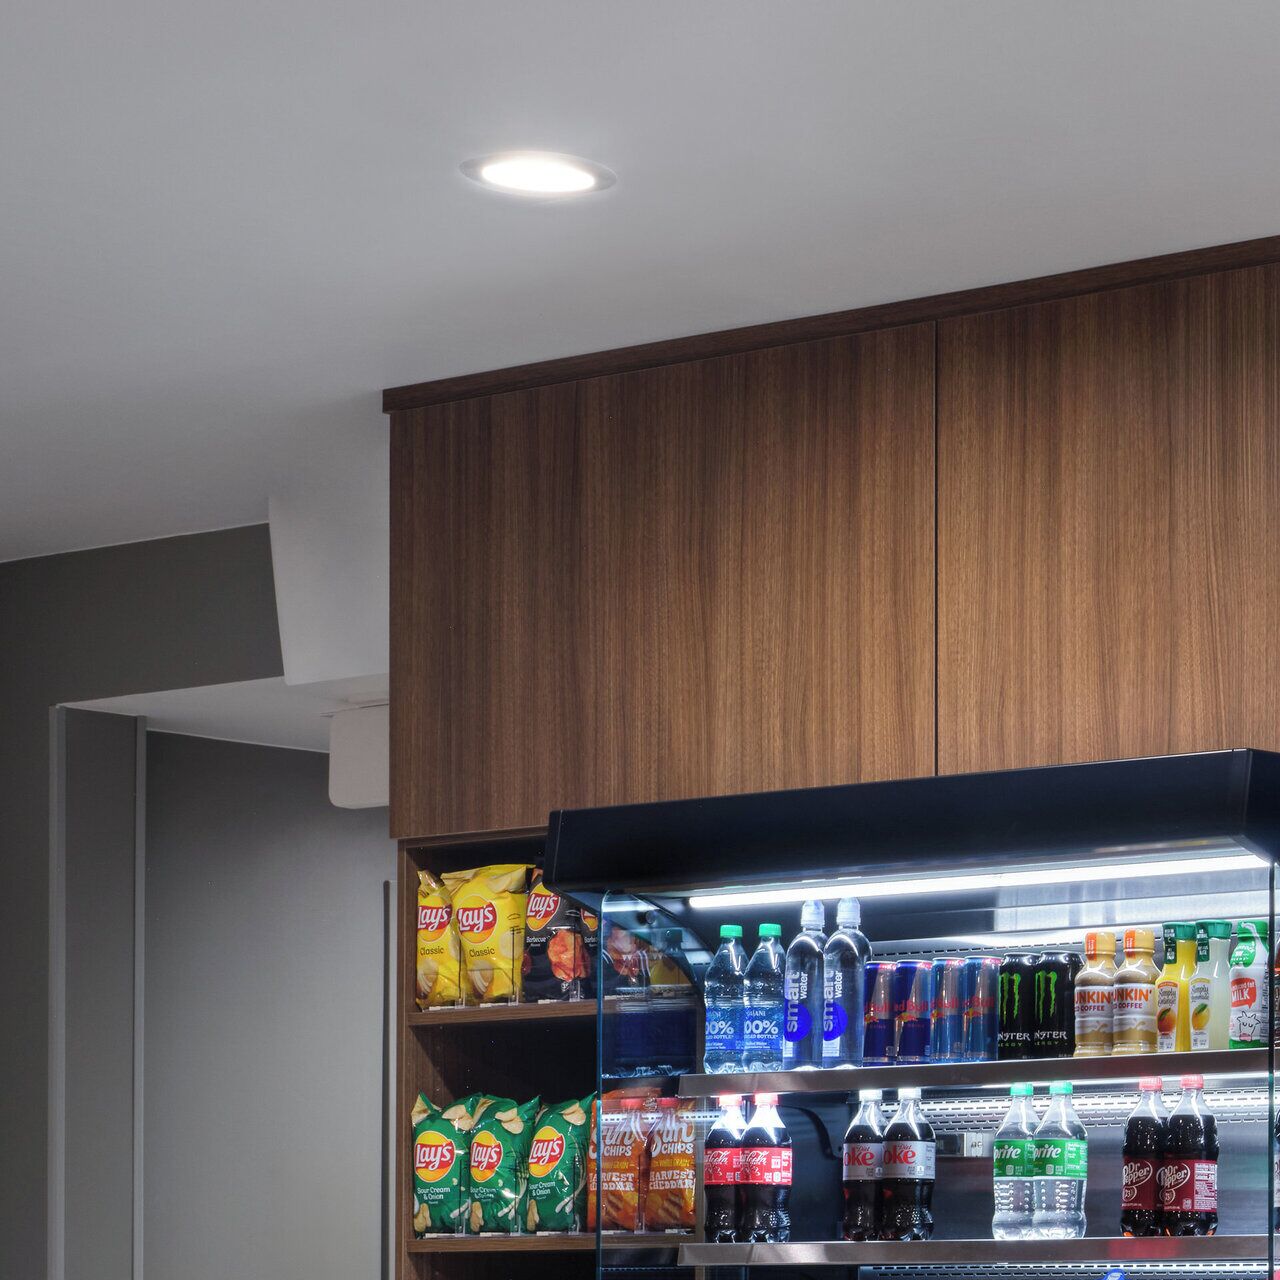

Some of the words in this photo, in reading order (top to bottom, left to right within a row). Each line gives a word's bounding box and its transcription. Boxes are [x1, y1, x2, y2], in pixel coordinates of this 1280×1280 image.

[418, 905, 452, 929] Lay's
[458, 906, 496, 932] Lay's
[527, 894, 559, 921] Lay's
[420, 947, 444, 955] Classic
[469, 948, 495, 957] Classic
[799, 971, 808, 999] water
[834, 971, 843, 998] water
[787, 971, 799, 1033] smart
[823, 971, 834, 1032] smart
[1081, 1004, 1105, 1012] COFFEE
[416, 1141, 454, 1169] Lay's
[471, 1142, 501, 1168] Lay's
[529, 1137, 564, 1165] Lay's
[662, 1143, 693, 1155] CHIPS
[1127, 1162, 1141, 1173] Dr
